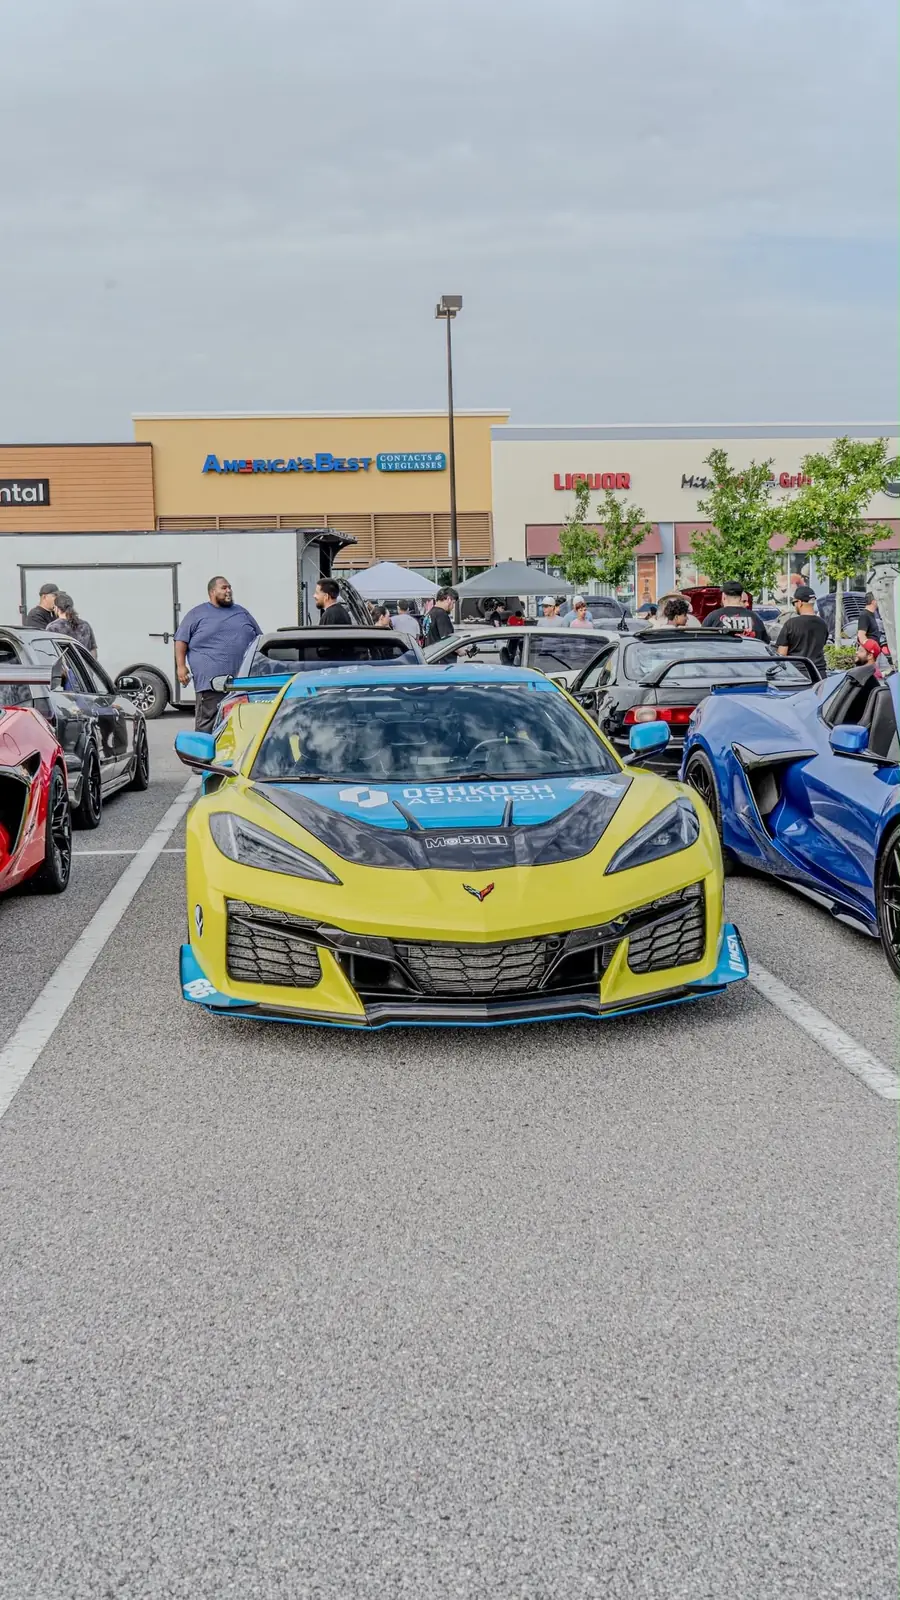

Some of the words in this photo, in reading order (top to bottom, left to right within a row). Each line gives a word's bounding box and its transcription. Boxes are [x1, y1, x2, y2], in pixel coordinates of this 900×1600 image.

[315, 453, 372, 472] BEST
[380, 454, 432, 462] CONTACTS
[381, 462, 442, 470] EYEGLASSES
[553, 473, 630, 491] LIQUOR
[323, 684, 521, 694] CORVETTE
[402, 784, 554, 798] OSHKOSH
[407, 793, 557, 806] AEROTECH
[425, 835, 485, 849] Mobil
